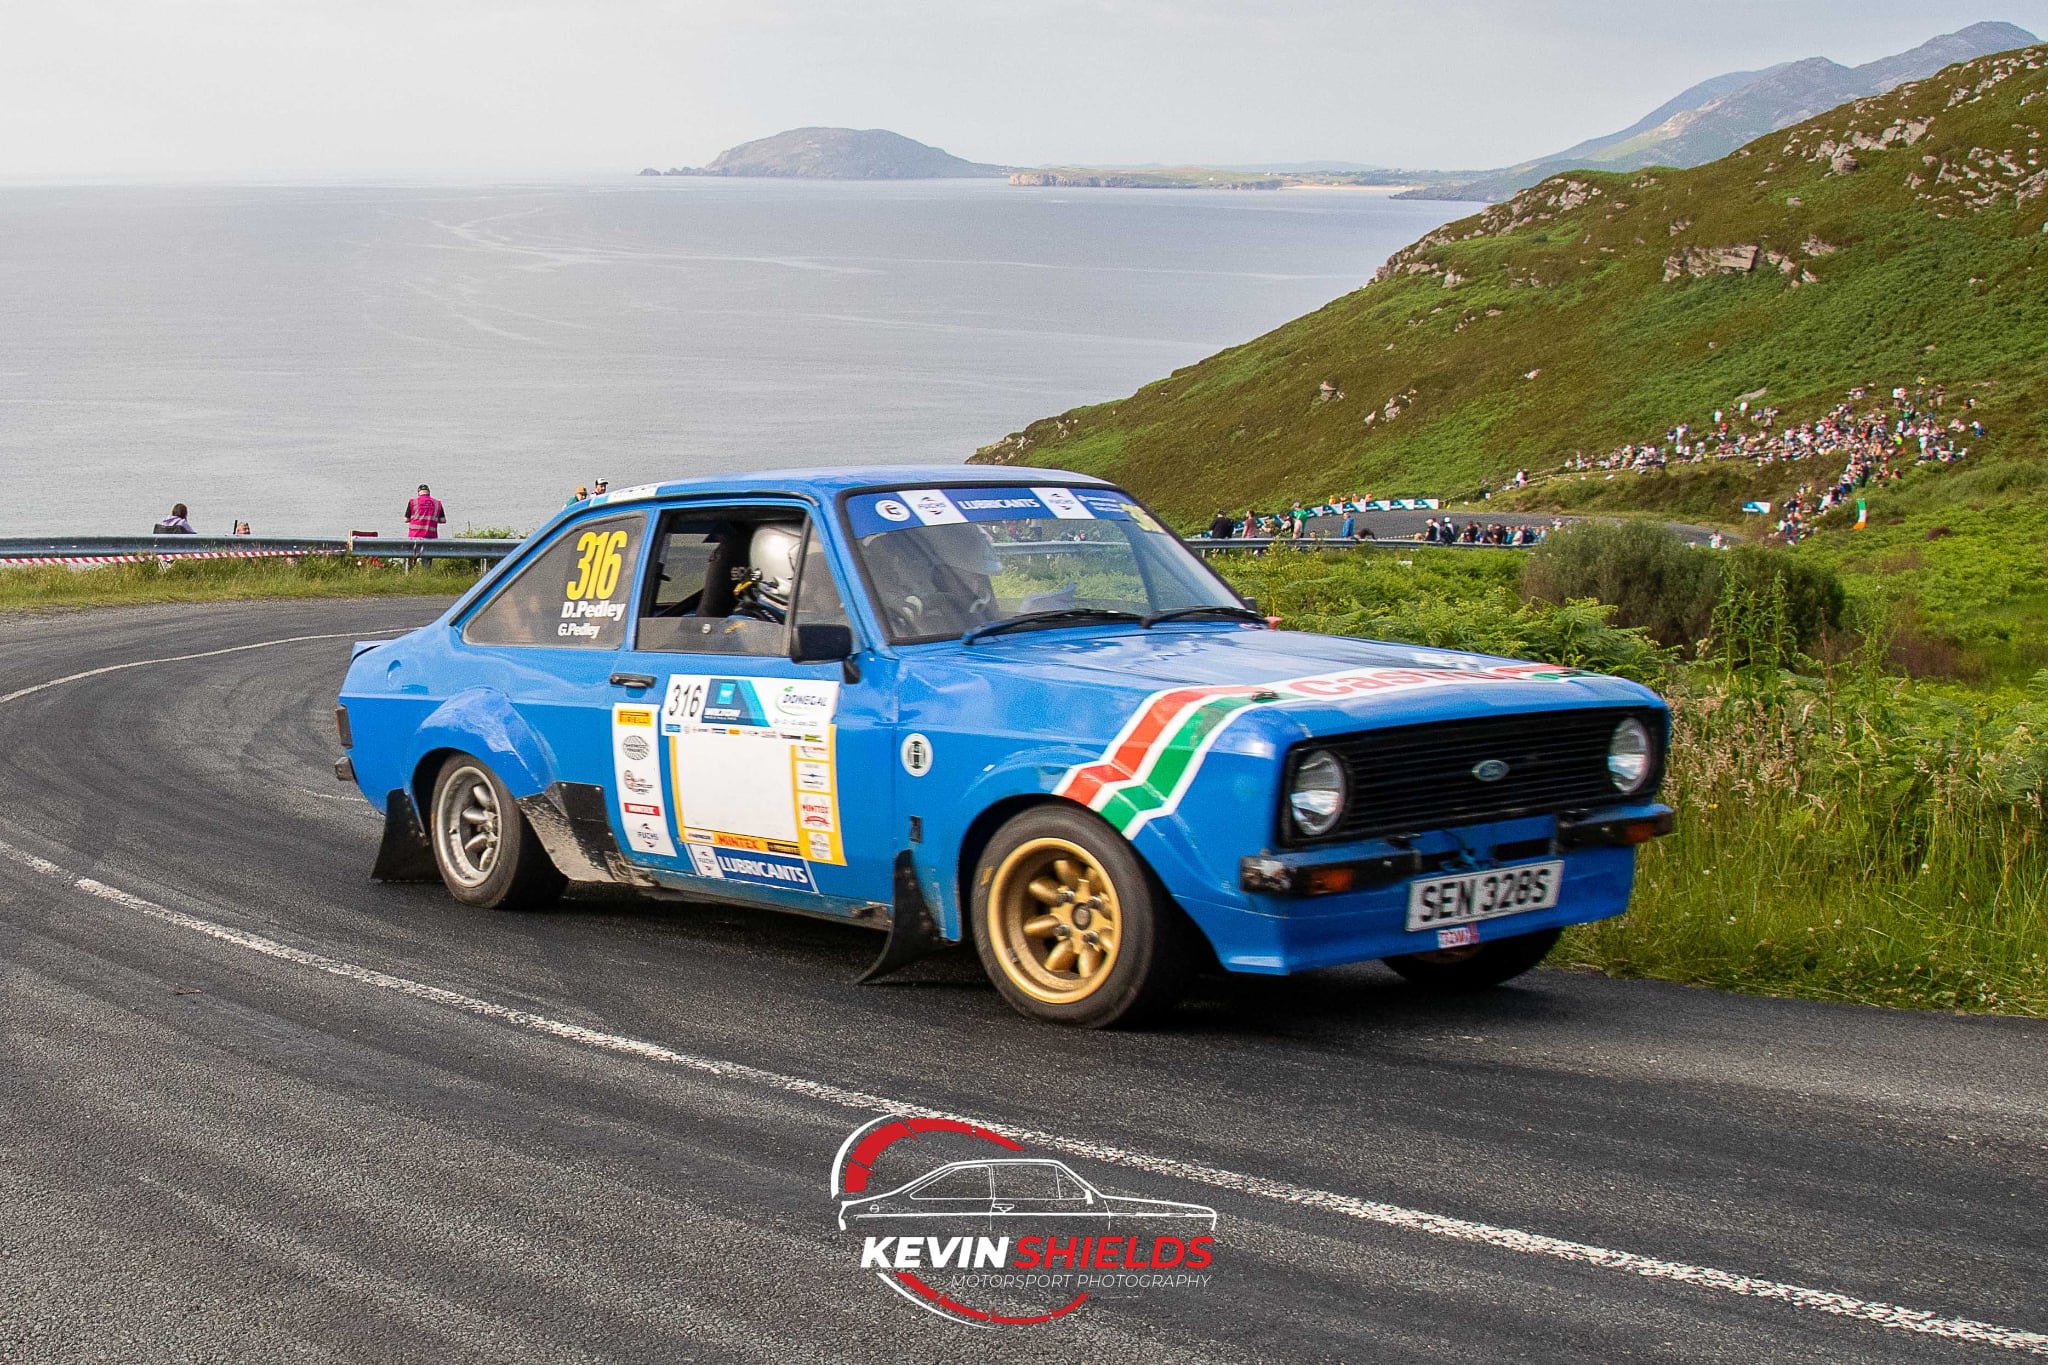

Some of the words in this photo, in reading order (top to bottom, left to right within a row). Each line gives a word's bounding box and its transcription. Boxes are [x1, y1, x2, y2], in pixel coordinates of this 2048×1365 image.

[957, 498, 1040, 510] LUBRICANTS
[566, 530, 628, 600] 316
[561, 600, 626, 621] D.Pedley
[557, 622, 601, 639] G.Pedley
[668, 683, 703, 718] 316
[719, 834, 759, 850] MINTEX
[717, 855, 809, 884] LUBRICANTS
[1420, 879, 1476, 922] SEN
[1481, 868, 1551, 912] 328S
